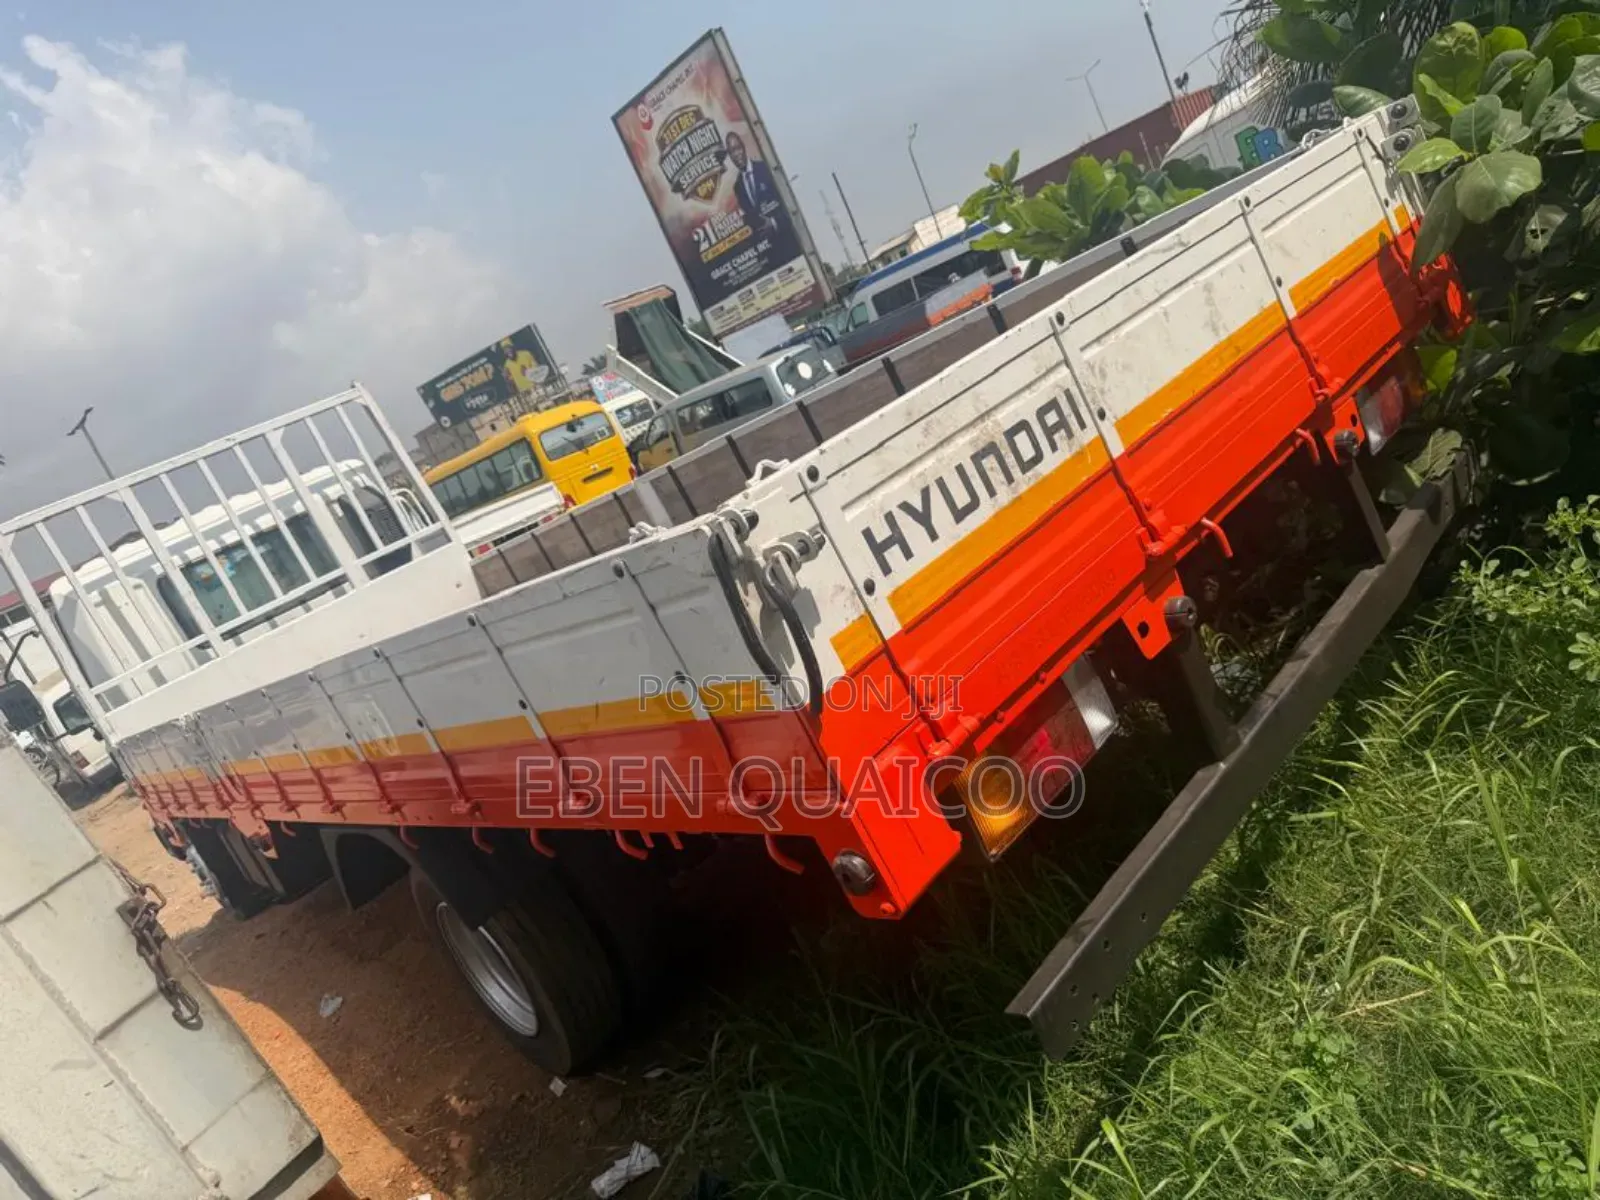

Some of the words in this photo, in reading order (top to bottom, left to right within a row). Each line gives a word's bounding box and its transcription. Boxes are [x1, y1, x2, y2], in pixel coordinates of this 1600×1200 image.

[679, 110, 697, 130] DEC
[661, 139, 692, 179] WATCH
[687, 122, 720, 155] NIGHT
[680, 154, 720, 188] SERVICE
[691, 219, 718, 252] 21
[710, 261, 733, 281] GRACE
[731, 247, 759, 269] CHAPEL
[861, 388, 1087, 577] HYUNDAI
